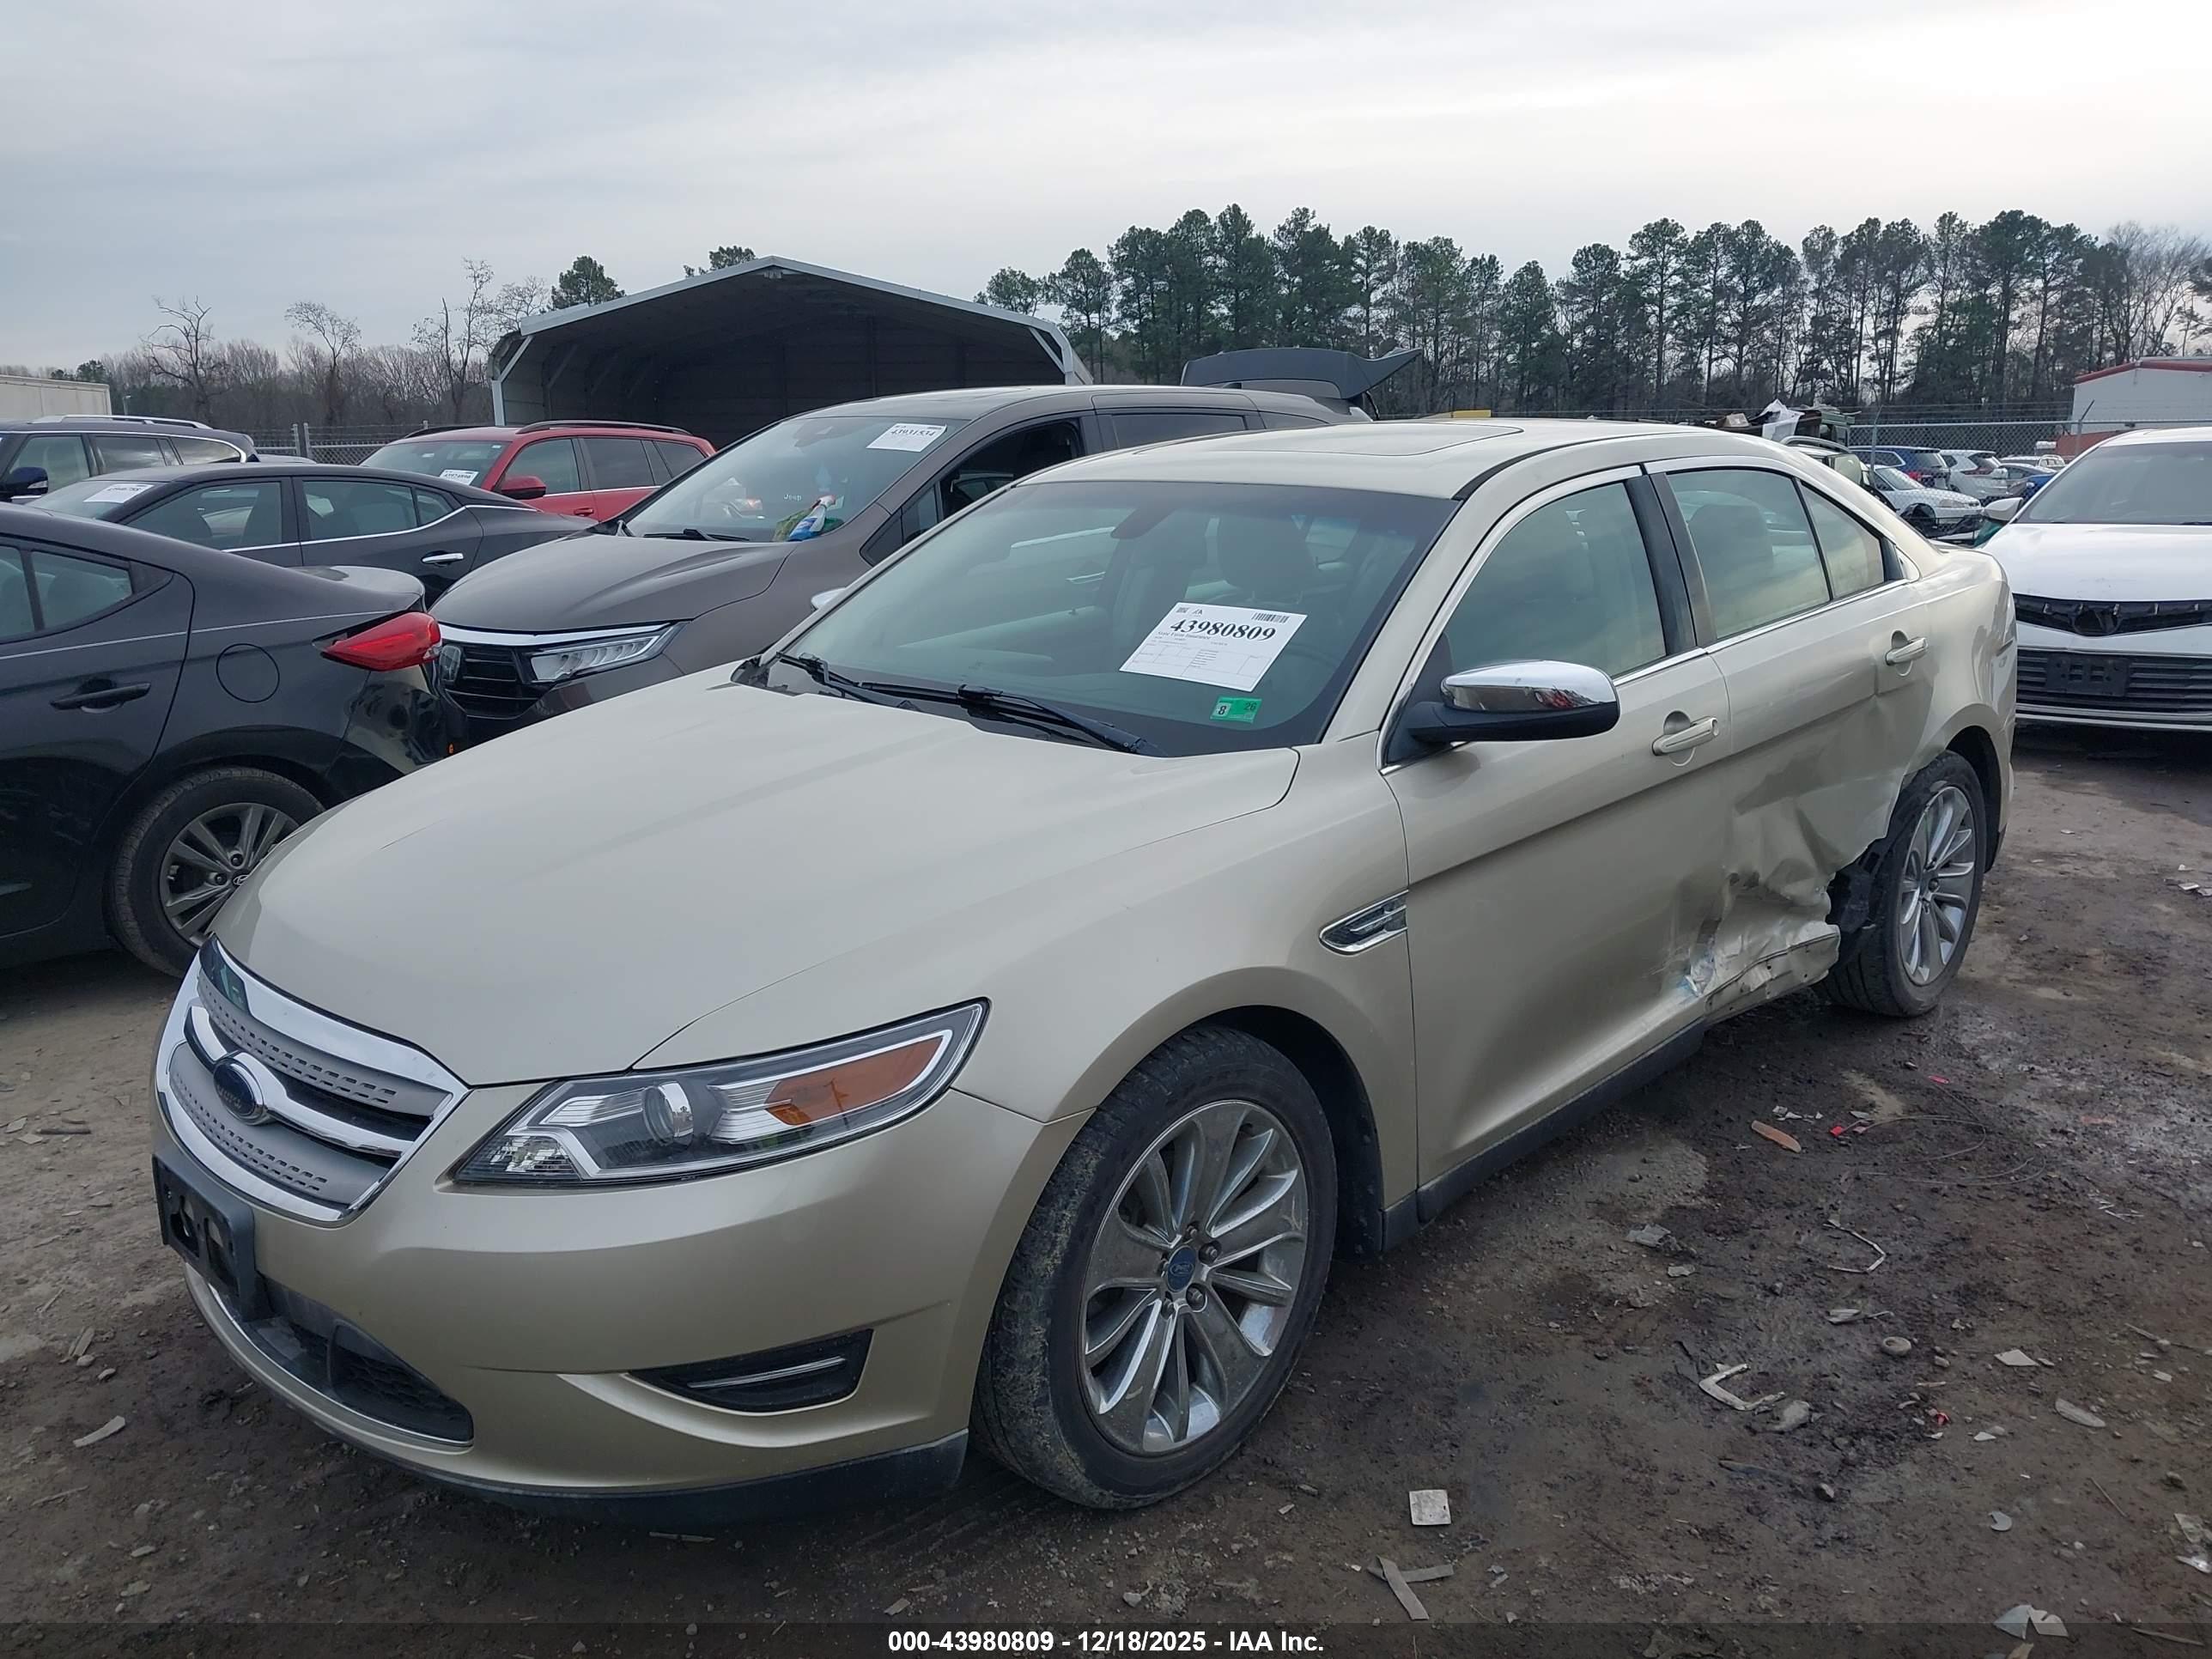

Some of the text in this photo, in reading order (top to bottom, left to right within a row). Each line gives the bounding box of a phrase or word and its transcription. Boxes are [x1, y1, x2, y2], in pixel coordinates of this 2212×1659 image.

[1170, 619, 1277, 641] 43980809
[1218, 705, 1226, 715] 8
[1244, 702, 1257, 711] 26
